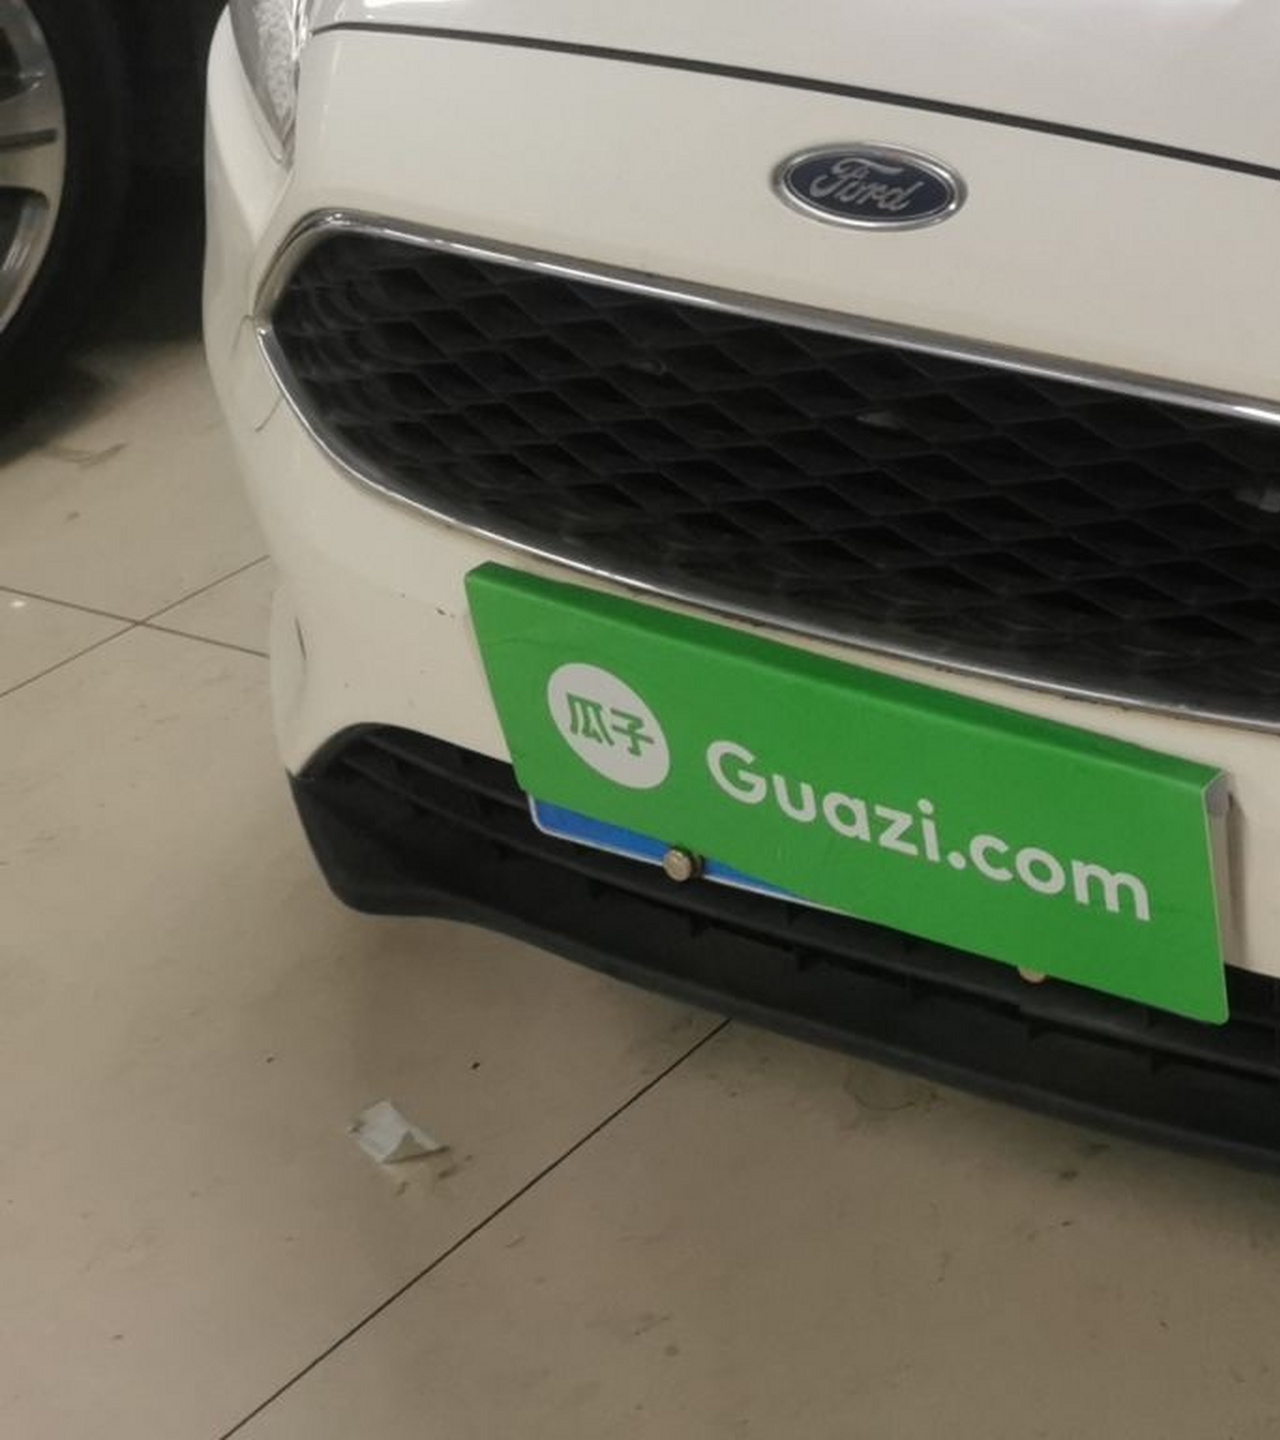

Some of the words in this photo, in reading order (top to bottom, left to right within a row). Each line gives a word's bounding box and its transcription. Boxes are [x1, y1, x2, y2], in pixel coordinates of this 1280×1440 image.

[809, 158, 924, 210] Ford
[566, 692, 655, 757] 瓜子
[705, 740, 1152, 922] Guazi.com
